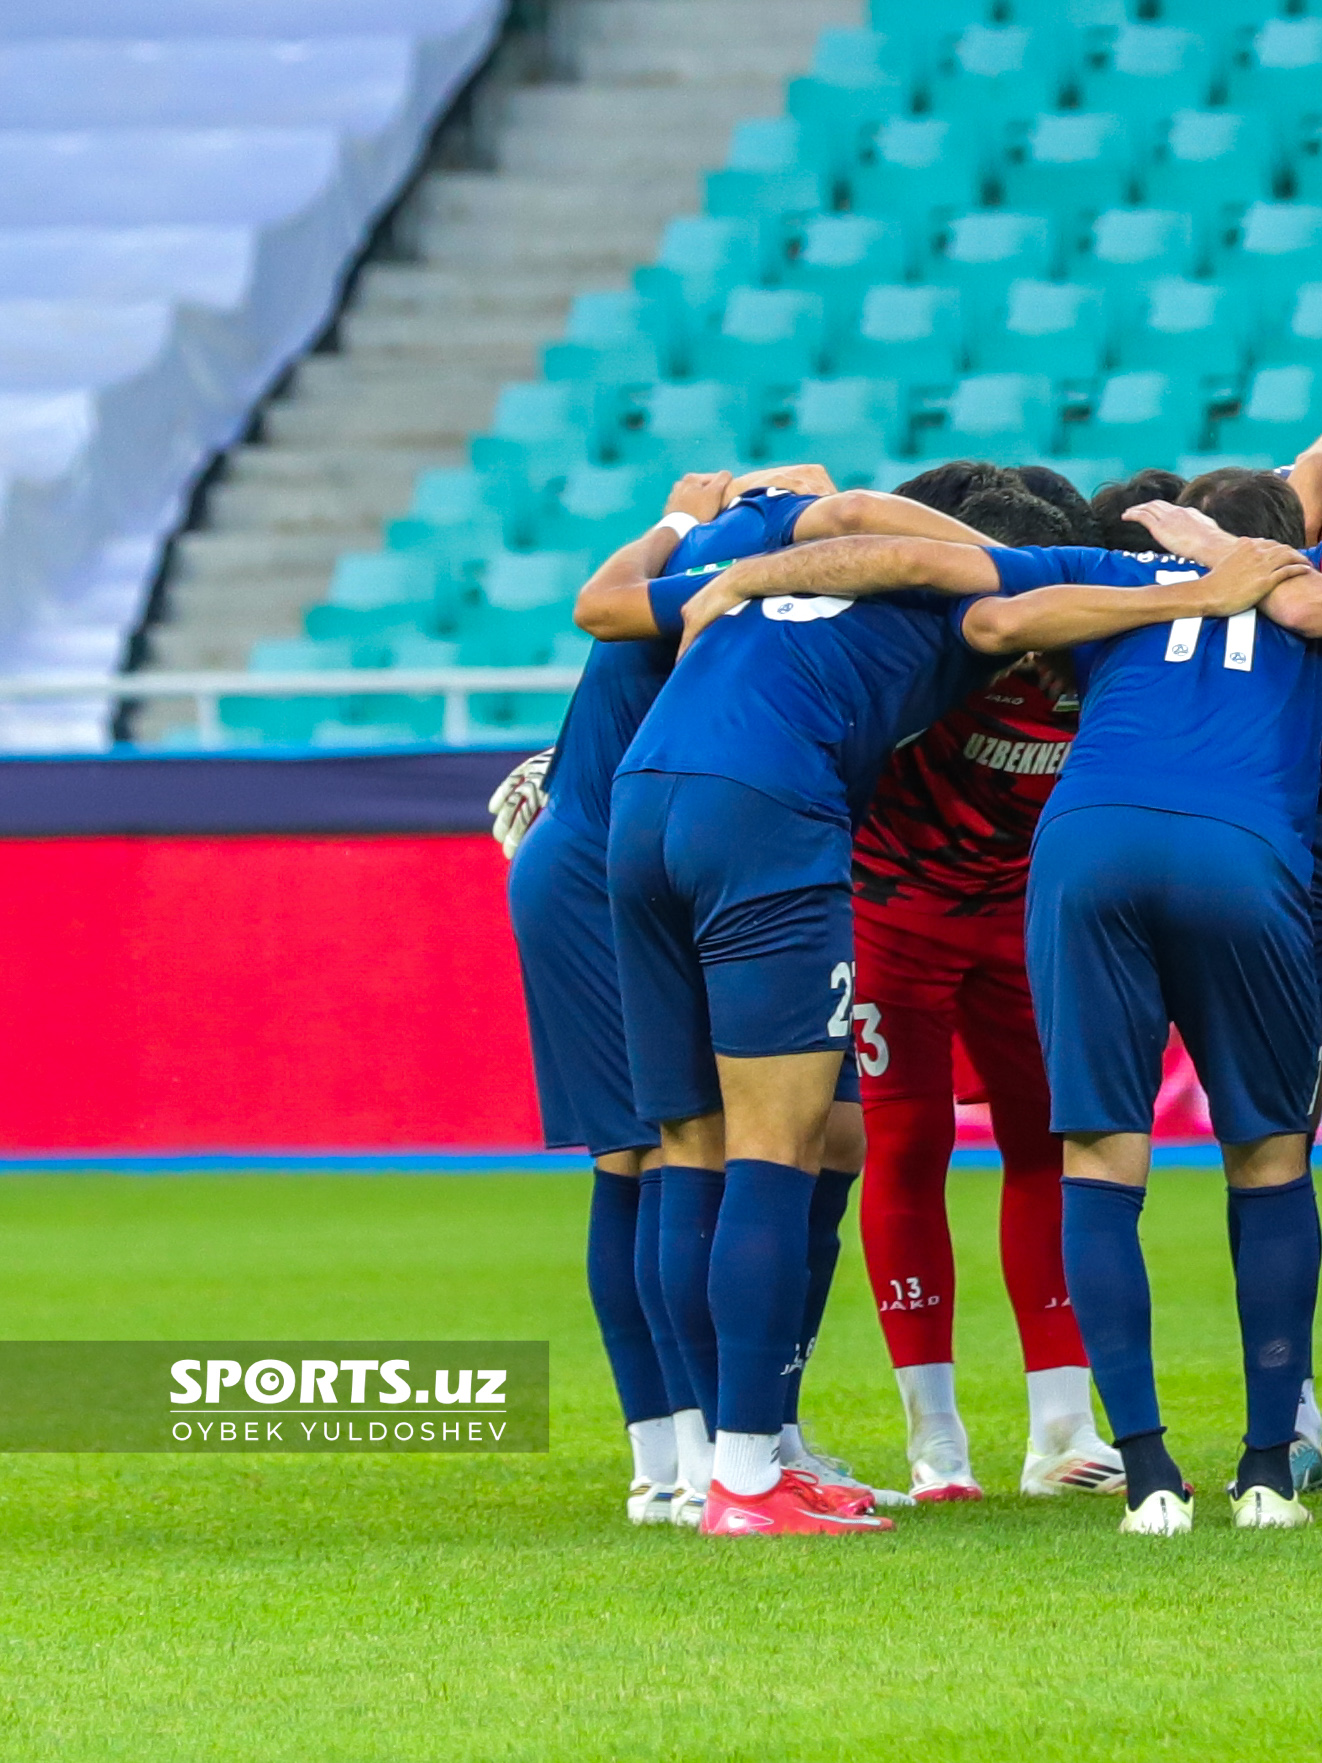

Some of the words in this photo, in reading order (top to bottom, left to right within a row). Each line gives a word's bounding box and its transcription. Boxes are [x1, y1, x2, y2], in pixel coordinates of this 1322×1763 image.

[827, 961, 856, 1038] 2
[852, 1002, 890, 1078] 3
[880, 1295, 941, 1312] JAKO
[890, 1276, 922, 1301] 13
